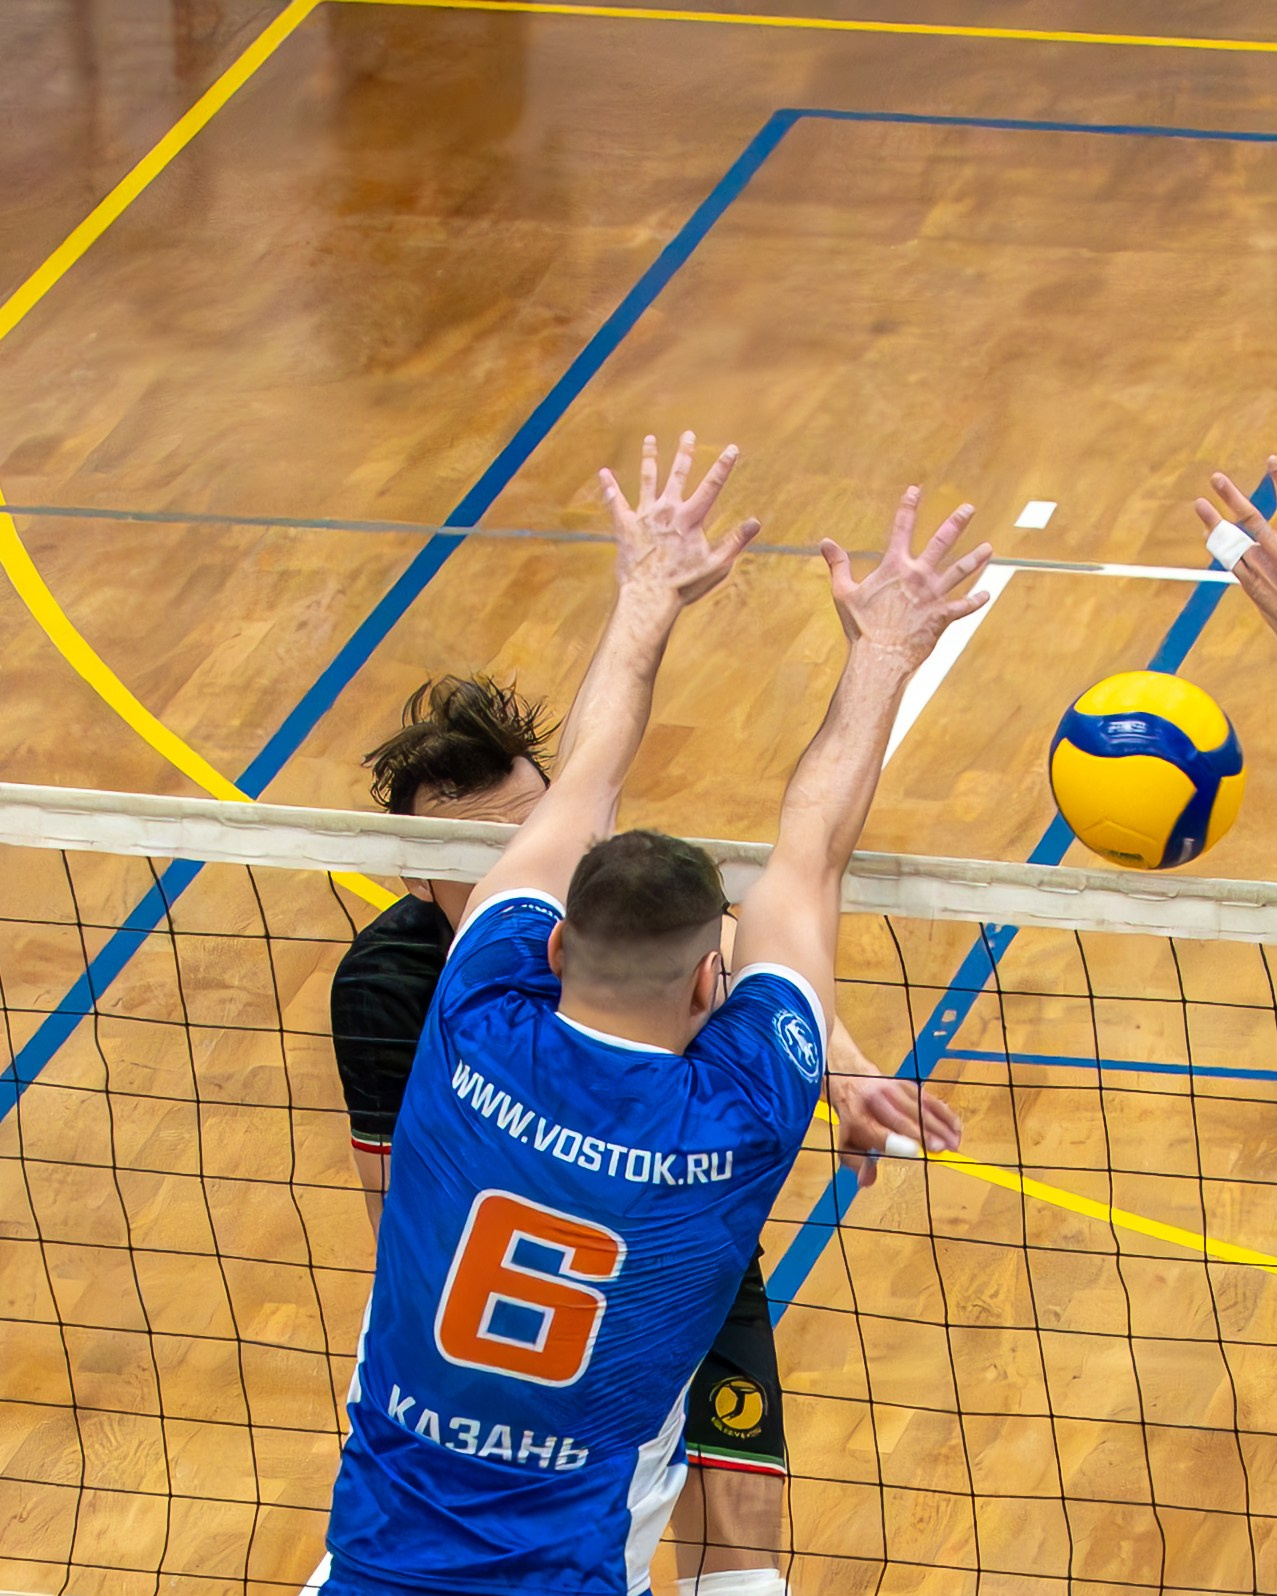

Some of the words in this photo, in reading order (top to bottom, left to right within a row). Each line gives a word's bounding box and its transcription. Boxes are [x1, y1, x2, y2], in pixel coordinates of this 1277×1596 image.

[452, 1059, 733, 1186] WWW.VOSTOK.RU
[434, 1188, 628, 1388] 6
[387, 1384, 590, 1471] КАЗАНЬ
